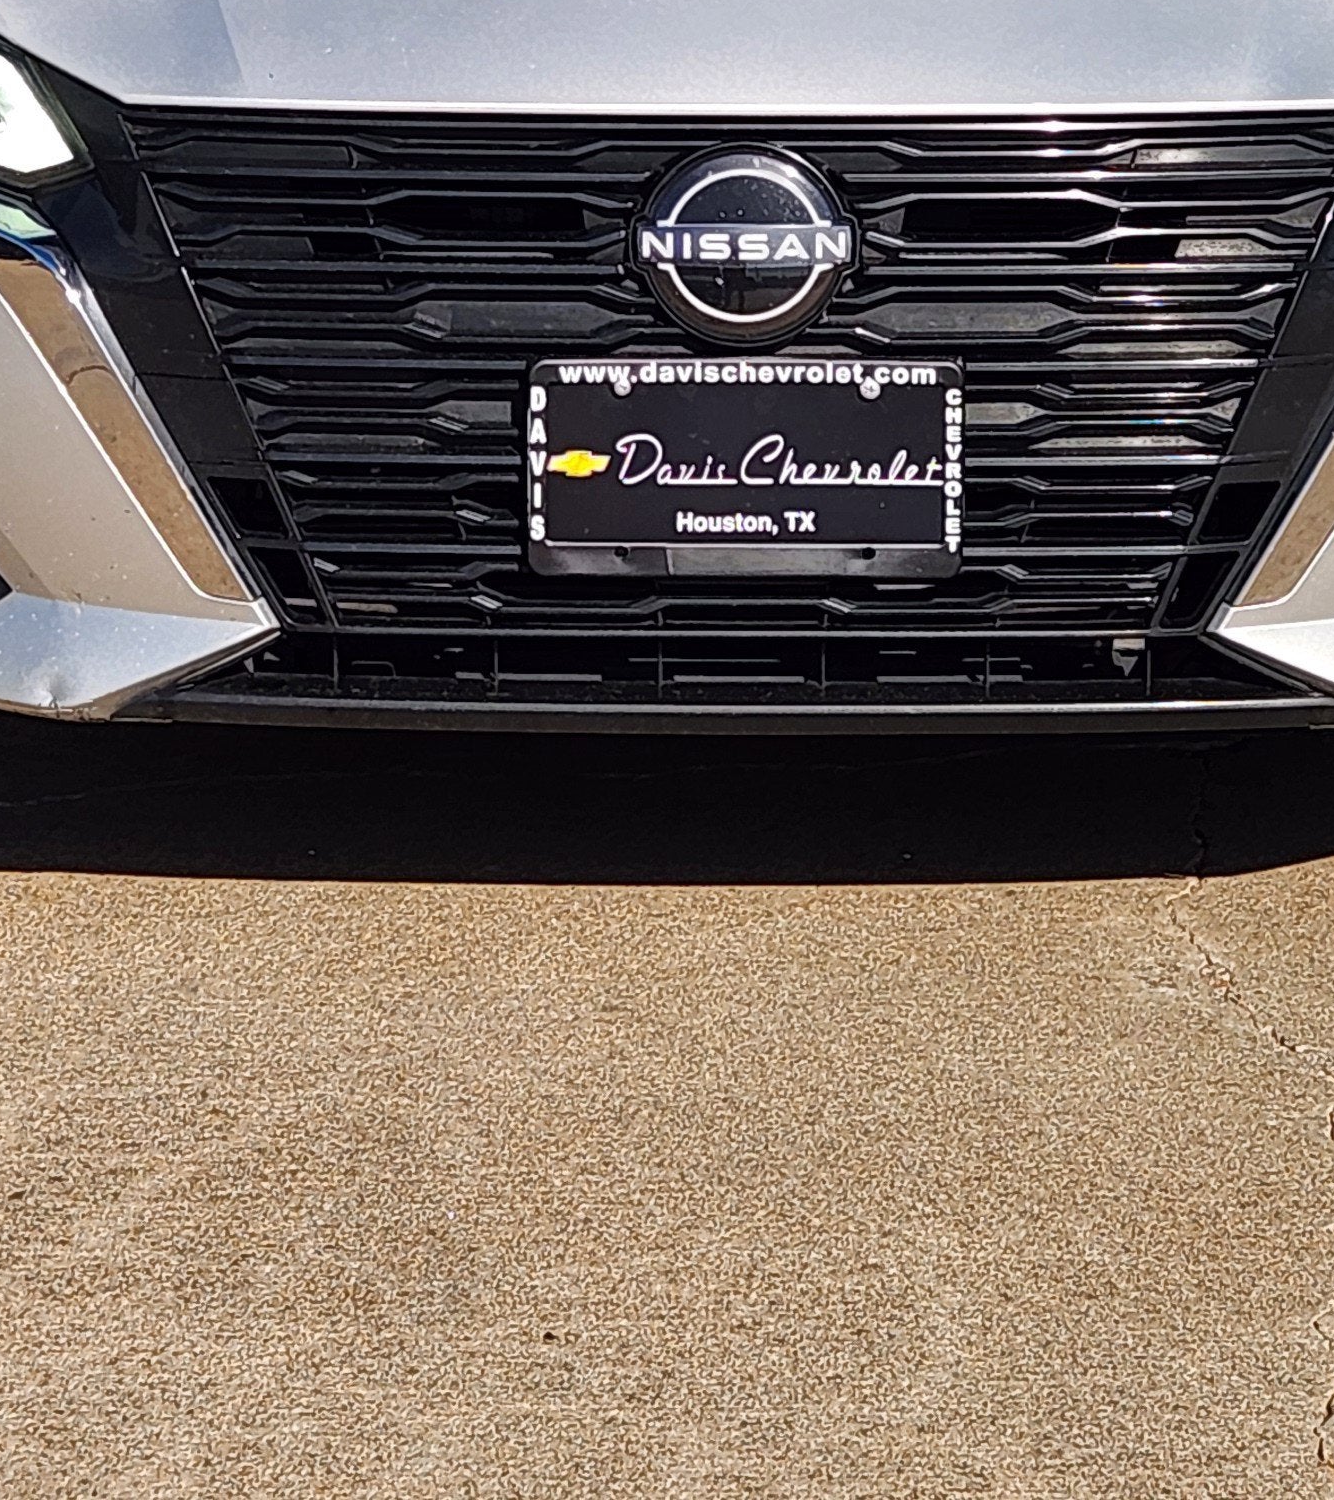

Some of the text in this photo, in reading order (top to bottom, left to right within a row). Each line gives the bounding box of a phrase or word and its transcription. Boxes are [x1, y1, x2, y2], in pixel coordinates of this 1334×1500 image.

[641, 230, 847, 261] NISSAN
[558, 360, 937, 385] www.davischevrolet.com
[529, 385, 548, 542] DAVIS
[615, 432, 944, 486] Davis Chevrolet
[944, 388, 963, 554] CHEVROLET
[676, 510, 817, 537] Houston, TX
